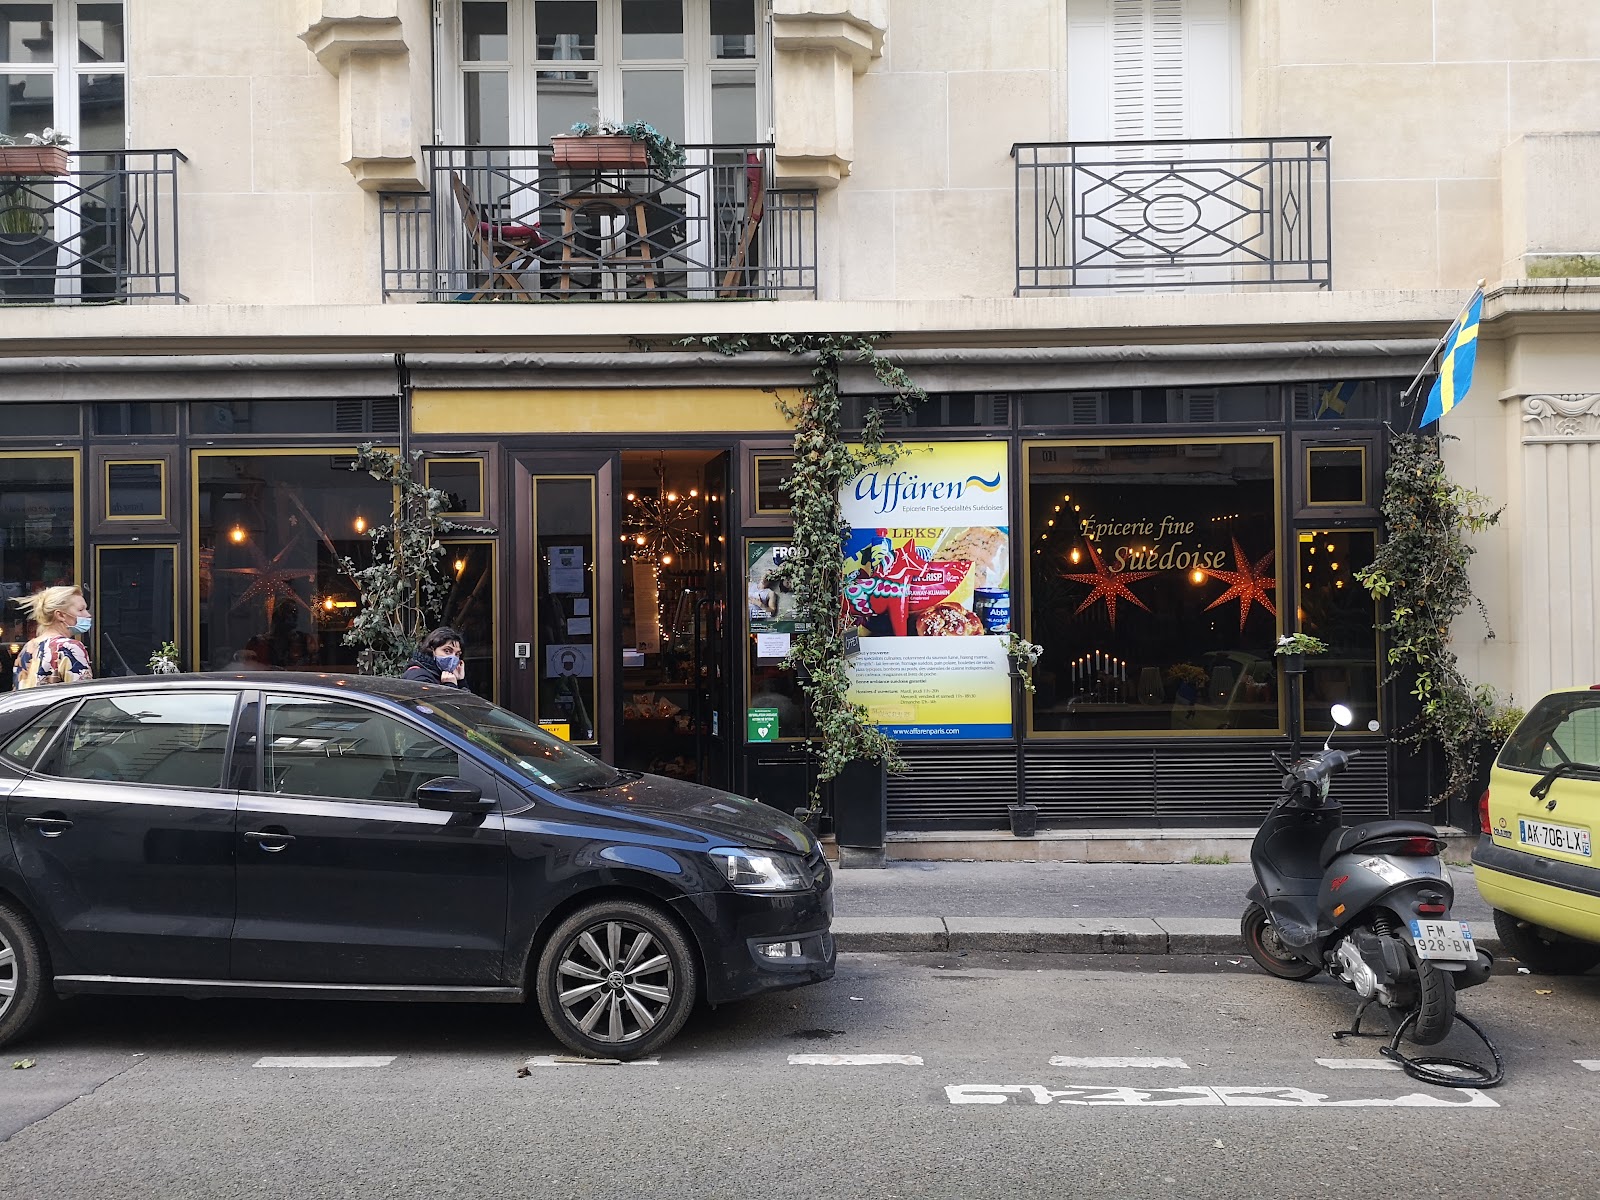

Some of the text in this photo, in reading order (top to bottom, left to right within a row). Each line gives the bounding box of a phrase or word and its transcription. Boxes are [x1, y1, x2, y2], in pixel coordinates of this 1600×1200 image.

[902, 505, 926, 513] Epicerie
[940, 504, 972, 513] Spécialités
[972, 503, 1003, 512] Suédoises
[1080, 514, 1195, 542] Épicerie fine
[1108, 541, 1226, 573] Suédoise
[990, 608, 1008, 617] Abba
[1527, 824, 1582, 852] AK-706-LX
[1418, 939, 1471, 953] 928-BW
